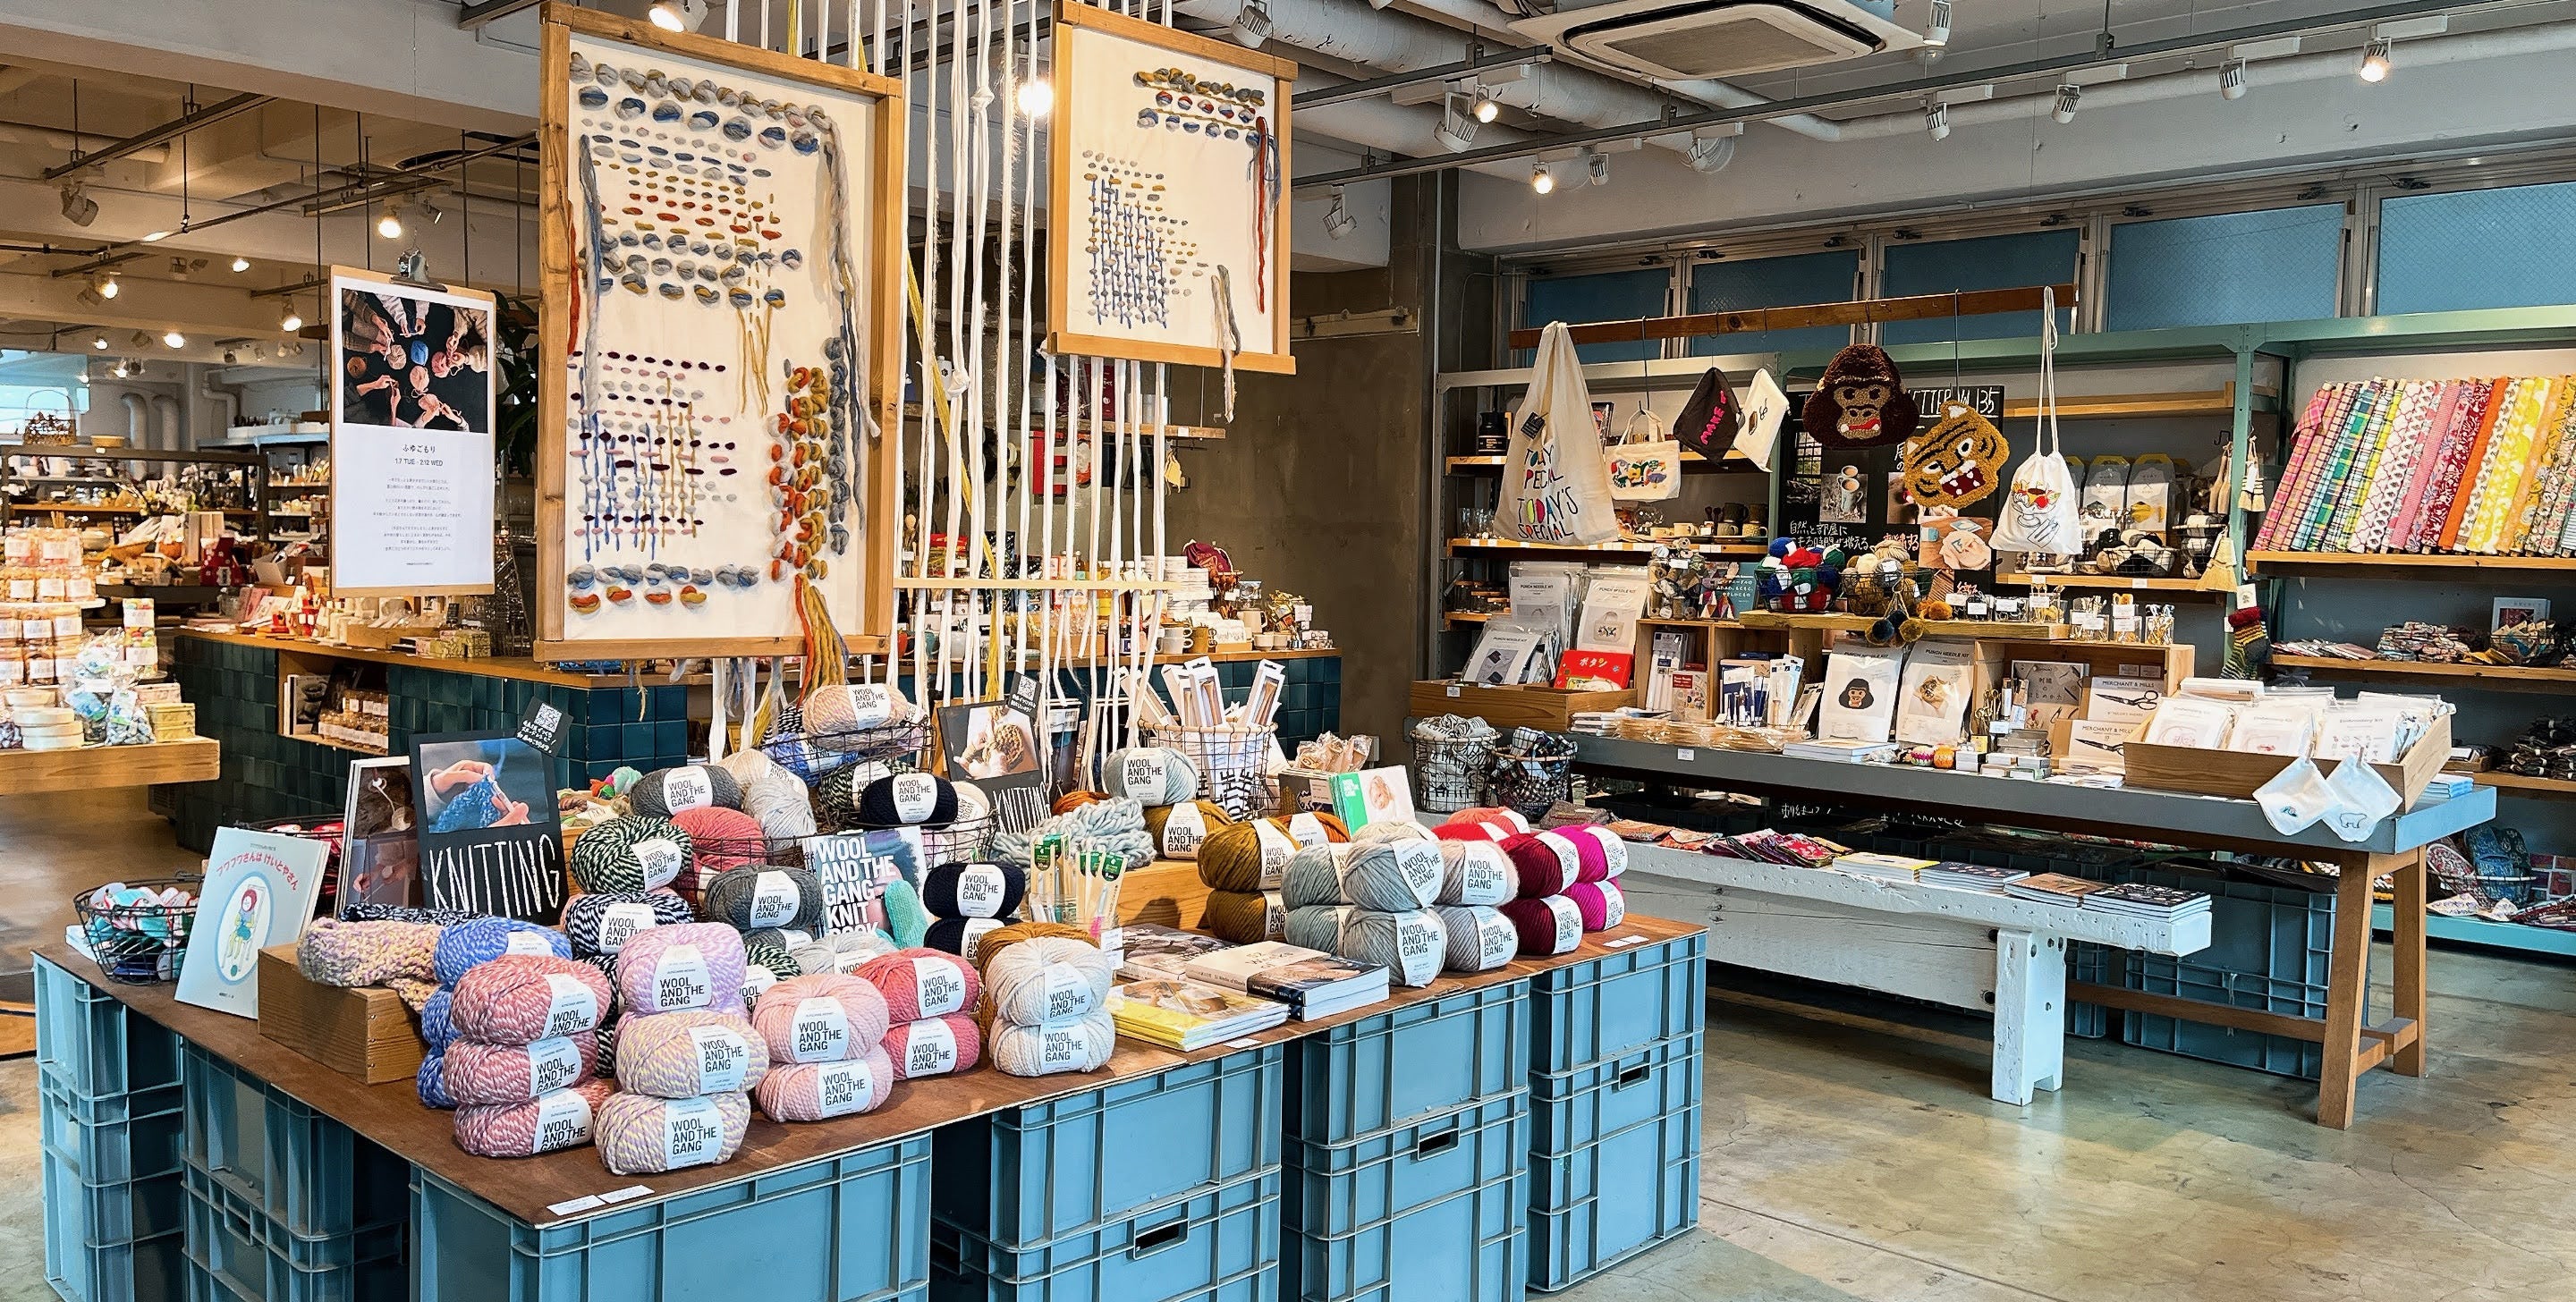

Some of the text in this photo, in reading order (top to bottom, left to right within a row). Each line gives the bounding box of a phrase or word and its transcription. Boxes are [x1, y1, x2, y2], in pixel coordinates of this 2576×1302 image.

[403, 444, 436, 454] ふゆごもり
[1517, 486, 1579, 525] TODAY'S
[1518, 520, 1574, 541] SPECIAL
[1580, 657, 1607, 668] ボタン
[855, 694, 870, 703] AND
[1127, 759, 1151, 767] WOOL
[1128, 767, 1162, 776] AND THE
[668, 780, 694, 790] WOOL
[898, 779, 920, 787] WOOL
[1128, 776, 1150, 785] GANG
[670, 786, 705, 799] AND THE
[900, 794, 920, 802] GANG
[672, 797, 695, 807] GANG
[1168, 827, 1193, 835] WOOL
[1168, 835, 1203, 844] AND THE
[815, 837, 873, 862] WOOL
[1168, 844, 1191, 852] GANG
[1266, 848, 1286, 856] WOOL
[644, 850, 666, 862] WOOL
[648, 853, 676, 871] AND THE
[1266, 857, 1280, 866] AND
[1401, 851, 1428, 870] WOOL
[821, 855, 896, 885] AND THE
[1408, 854, 1440, 880] AND THE
[1468, 860, 1492, 870] WOOL
[263, 853, 301, 892] けいとやさん
[429, 833, 560, 919] KNITTING
[648, 866, 667, 878] GANG
[1468, 869, 1504, 880] AND THE
[966, 875, 988, 884] WOOL
[1413, 869, 1435, 889] GANG
[1468, 879, 1492, 889] GANG
[823, 879, 876, 907] GANG
[963, 884, 998, 893] AND THE
[758, 896, 783, 904] WOOL
[963, 892, 986, 900] GANG
[757, 904, 775, 912] AND
[826, 901, 869, 928] KNIT
[608, 917, 635, 928] WOOL
[606, 927, 626, 936] AND
[1400, 924, 1427, 935] WOOL
[1481, 926, 1502, 937] WOOL
[606, 936, 625, 945] GAN
[1402, 931, 1438, 946] AND THE
[1485, 932, 1513, 949] AND THE
[1403, 944, 1428, 956] GANG
[1485, 944, 1504, 957] GANG
[660, 977, 691, 988] WOOL
[923, 976, 948, 988] WOOL
[661, 985, 704, 998] AND THE
[925, 982, 959, 999] AND THE
[1049, 990, 1075, 1002] WOOL
[661, 996, 690, 1007] GANG
[925, 994, 948, 1007] GANG
[1050, 995, 1085, 1011] AND THE
[554, 1010, 580, 1023] WOOL
[1050, 1007, 1072, 1018] GANG
[550, 1017, 590, 1033] AND THE
[799, 1021, 829, 1033] WOOL
[800, 1029, 842, 1043] AND THE
[1045, 1032, 1072, 1042] WOOL
[699, 1040, 730, 1050] WOOL
[800, 1042, 827, 1052] GANG
[912, 1043, 939, 1054] WOOL
[1046, 1041, 1082, 1053] AND THE
[705, 1046, 743, 1061] AND THE
[912, 1051, 950, 1063] AND THE
[1046, 1052, 1071, 1061] GANG
[537, 1058, 564, 1074] WOOL
[705, 1059, 731, 1073] GANG
[911, 1061, 937, 1071] GANG
[538, 1063, 575, 1086] AND THE
[823, 1072, 852, 1086] WOOL
[537, 1078, 562, 1094] GANG
[825, 1079, 865, 1096] AND THE
[826, 1093, 852, 1105] GANG
[544, 1120, 572, 1133] WOOL
[672, 1119, 704, 1132] WOOL
[542, 1127, 586, 1144] AND THE
[673, 1127, 716, 1144] AND THE
[673, 1141, 701, 1154] GANG
